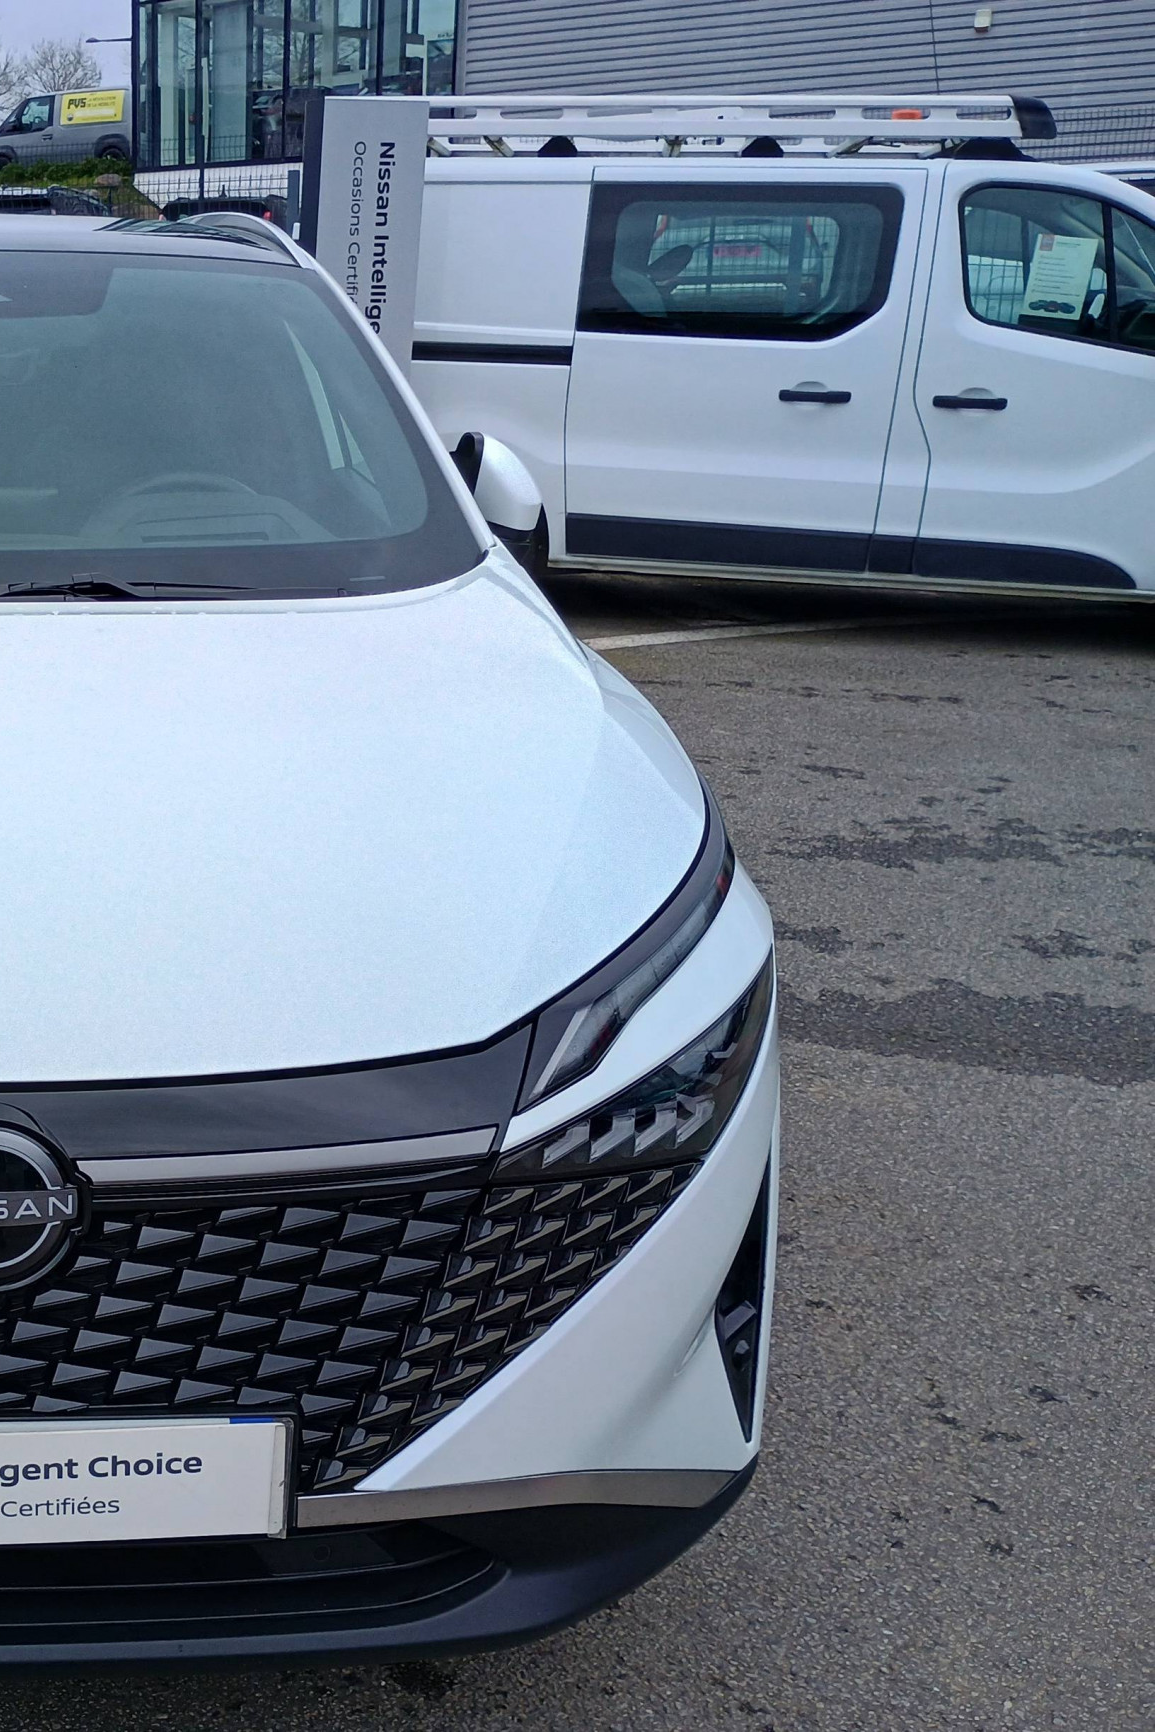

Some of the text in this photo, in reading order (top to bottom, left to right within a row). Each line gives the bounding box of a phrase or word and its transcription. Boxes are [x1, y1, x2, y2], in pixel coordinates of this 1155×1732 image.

[349, 141, 366, 236] Occasions
[375, 142, 396, 227] Nissan
[84, 1451, 204, 1479] Choice
[1, 1496, 121, 1518] Certifiées
